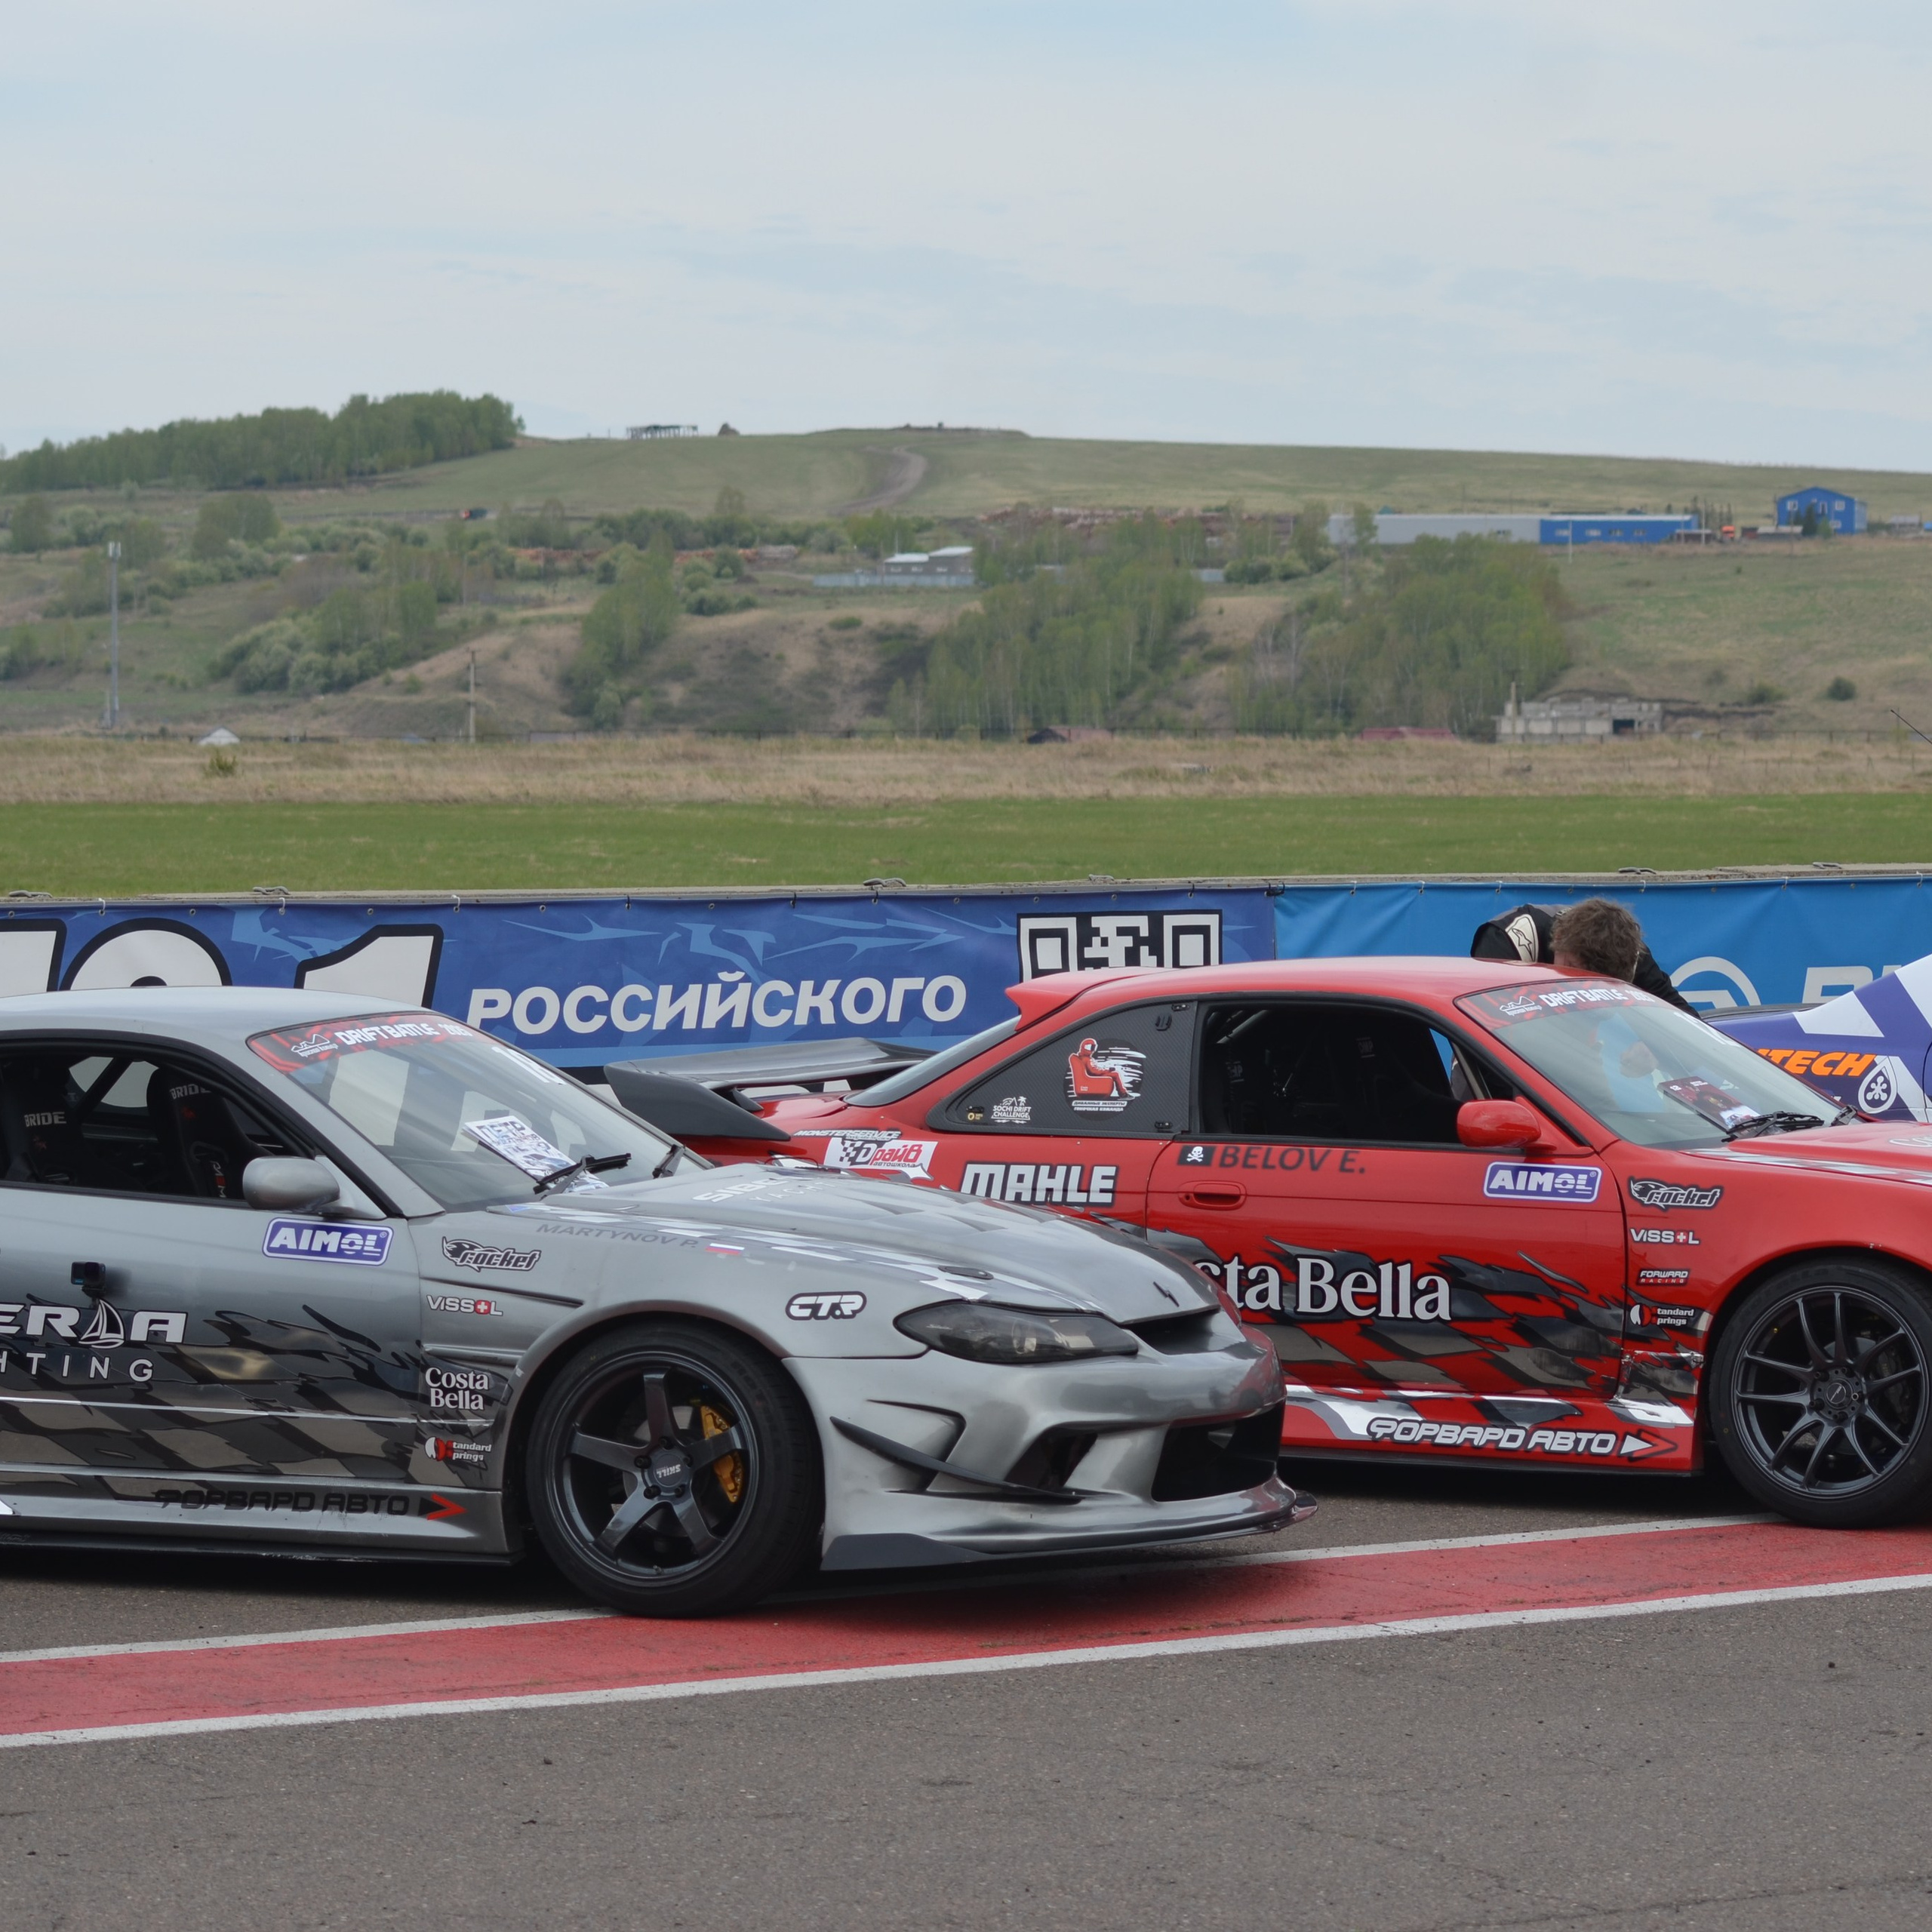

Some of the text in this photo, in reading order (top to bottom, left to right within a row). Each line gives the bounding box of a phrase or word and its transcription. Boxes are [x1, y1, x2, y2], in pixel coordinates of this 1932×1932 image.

[467, 971, 966, 1035] РОССИЙСКОГО
[1538, 990, 1585, 1008] DRIFT
[334, 1026, 388, 1046] DRIFT
[1757, 1048, 1877, 1076] TECH
[24, 1112, 66, 1128] BRIDE
[1219, 1145, 1334, 1173] BELOV
[959, 1162, 1118, 1204] MAHLE
[535, 1223, 678, 1247] MARTYNOV
[1639, 1269, 1689, 1278] FORWARD
[1297, 1257, 1451, 1321] Bella
[425, 1367, 489, 1390] Costa
[430, 1387, 485, 1411] Bella
